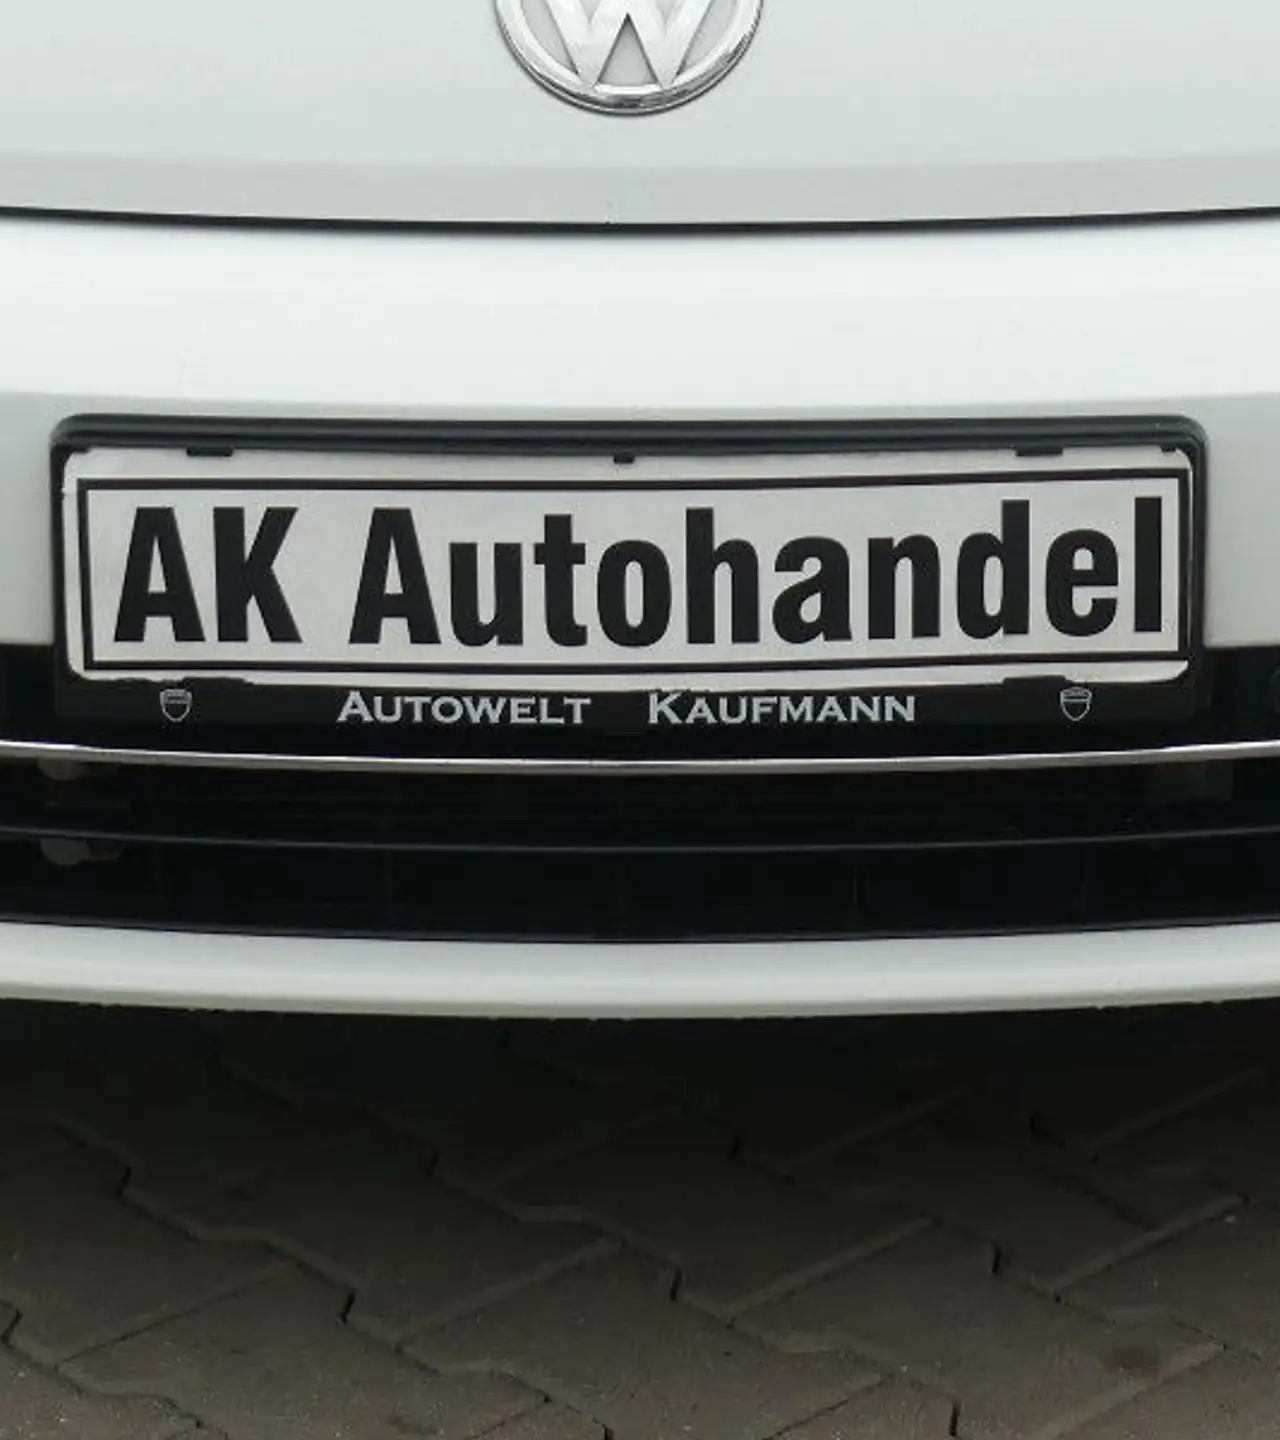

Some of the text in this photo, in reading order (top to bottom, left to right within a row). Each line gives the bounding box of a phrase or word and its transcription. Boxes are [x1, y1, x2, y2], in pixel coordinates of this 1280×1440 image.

[113, 497, 1162, 647] AK Autohandel
[337, 691, 916, 724] AUTOWELT KAUFMANN
